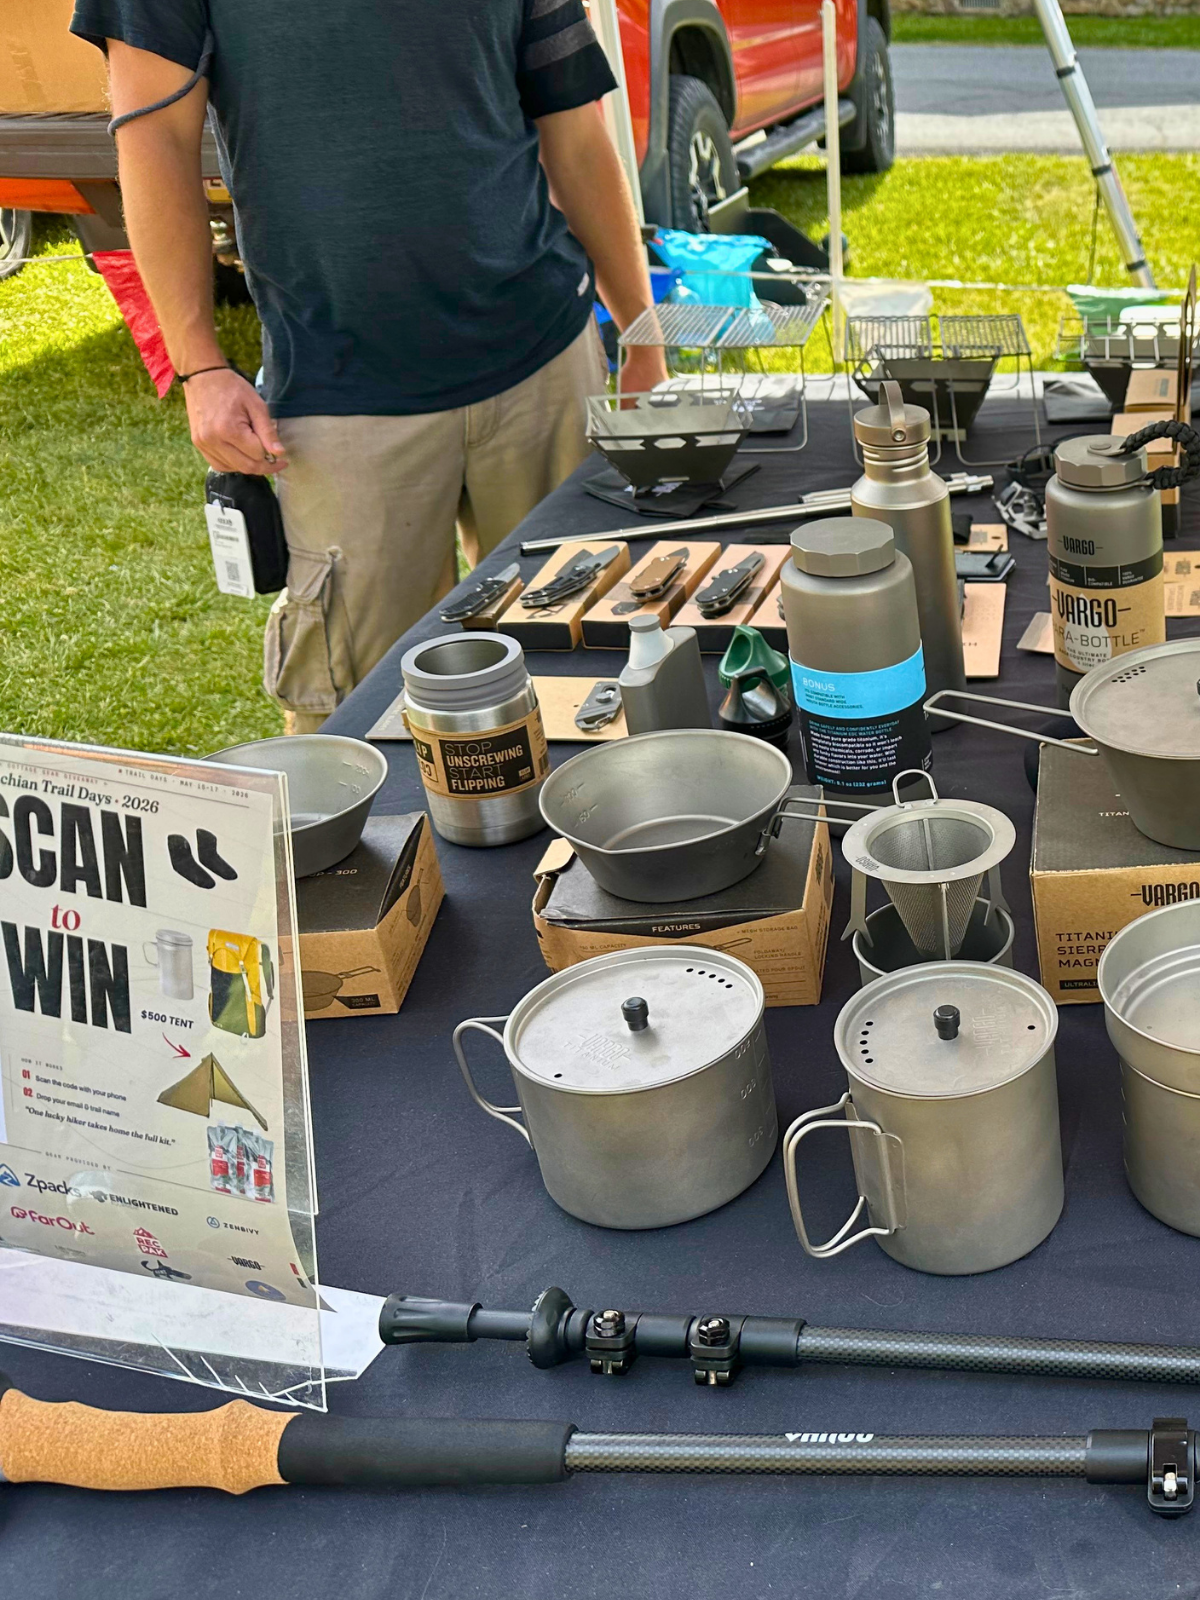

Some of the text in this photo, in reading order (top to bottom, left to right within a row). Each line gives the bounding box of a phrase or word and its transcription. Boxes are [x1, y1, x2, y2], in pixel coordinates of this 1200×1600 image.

[1063, 535, 1095, 556] VARGO
[1056, 589, 1118, 628] VARGO
[1054, 624, 1145, 648] ARA-BOTTLE™
[802, 677, 836, 692] BONUS
[444, 741, 492, 756] STOP
[446, 744, 524, 768] UNSCREWING
[7, 763, 37, 774] COTTAGE
[64, 773, 98, 785] GIVEAWAY
[449, 763, 504, 779] START
[0, 773, 160, 814] chian Trail Days 2026
[125, 769, 146, 780] TRAIL
[150, 774, 168, 783] DAYS
[180, 780, 193, 788] MAY
[232, 789, 249, 799] 2026
[451, 776, 506, 791] FLIPPING
[335, 868, 358, 876] 300
[1141, 881, 1200, 907] VARGO
[50, 904, 81, 931] to
[652, 923, 701, 933] FEATURES
[1055, 931, 1117, 942] TITANI
[1, 920, 132, 1034] WIN
[141, 1009, 194, 1030] $500 TENT
[22, 1069, 127, 1102] 01 Scan the code with your phone
[23, 1086, 33, 1098] 02
[36, 1092, 51, 1103] Drop
[52, 1096, 66, 1106] your
[66, 1100, 83, 1110] email
[90, 1105, 102, 1113] trail
[102, 1108, 120, 1117] name
[45, 1110, 65, 1122] lucky
[66, 1115, 86, 1127] hiker
[87, 1120, 107, 1132] takes
[109, 1125, 130, 1137] home
[131, 1130, 143, 1140] the
[144, 1133, 158, 1143] full
[24, 1172, 82, 1198] Zpacks
[109, 1193, 179, 1216] ENLIGHTENED
[223, 1222, 260, 1236] ZENBIVY
[136, 1236, 161, 1248] REC
[230, 1255, 263, 1270] VARGO
